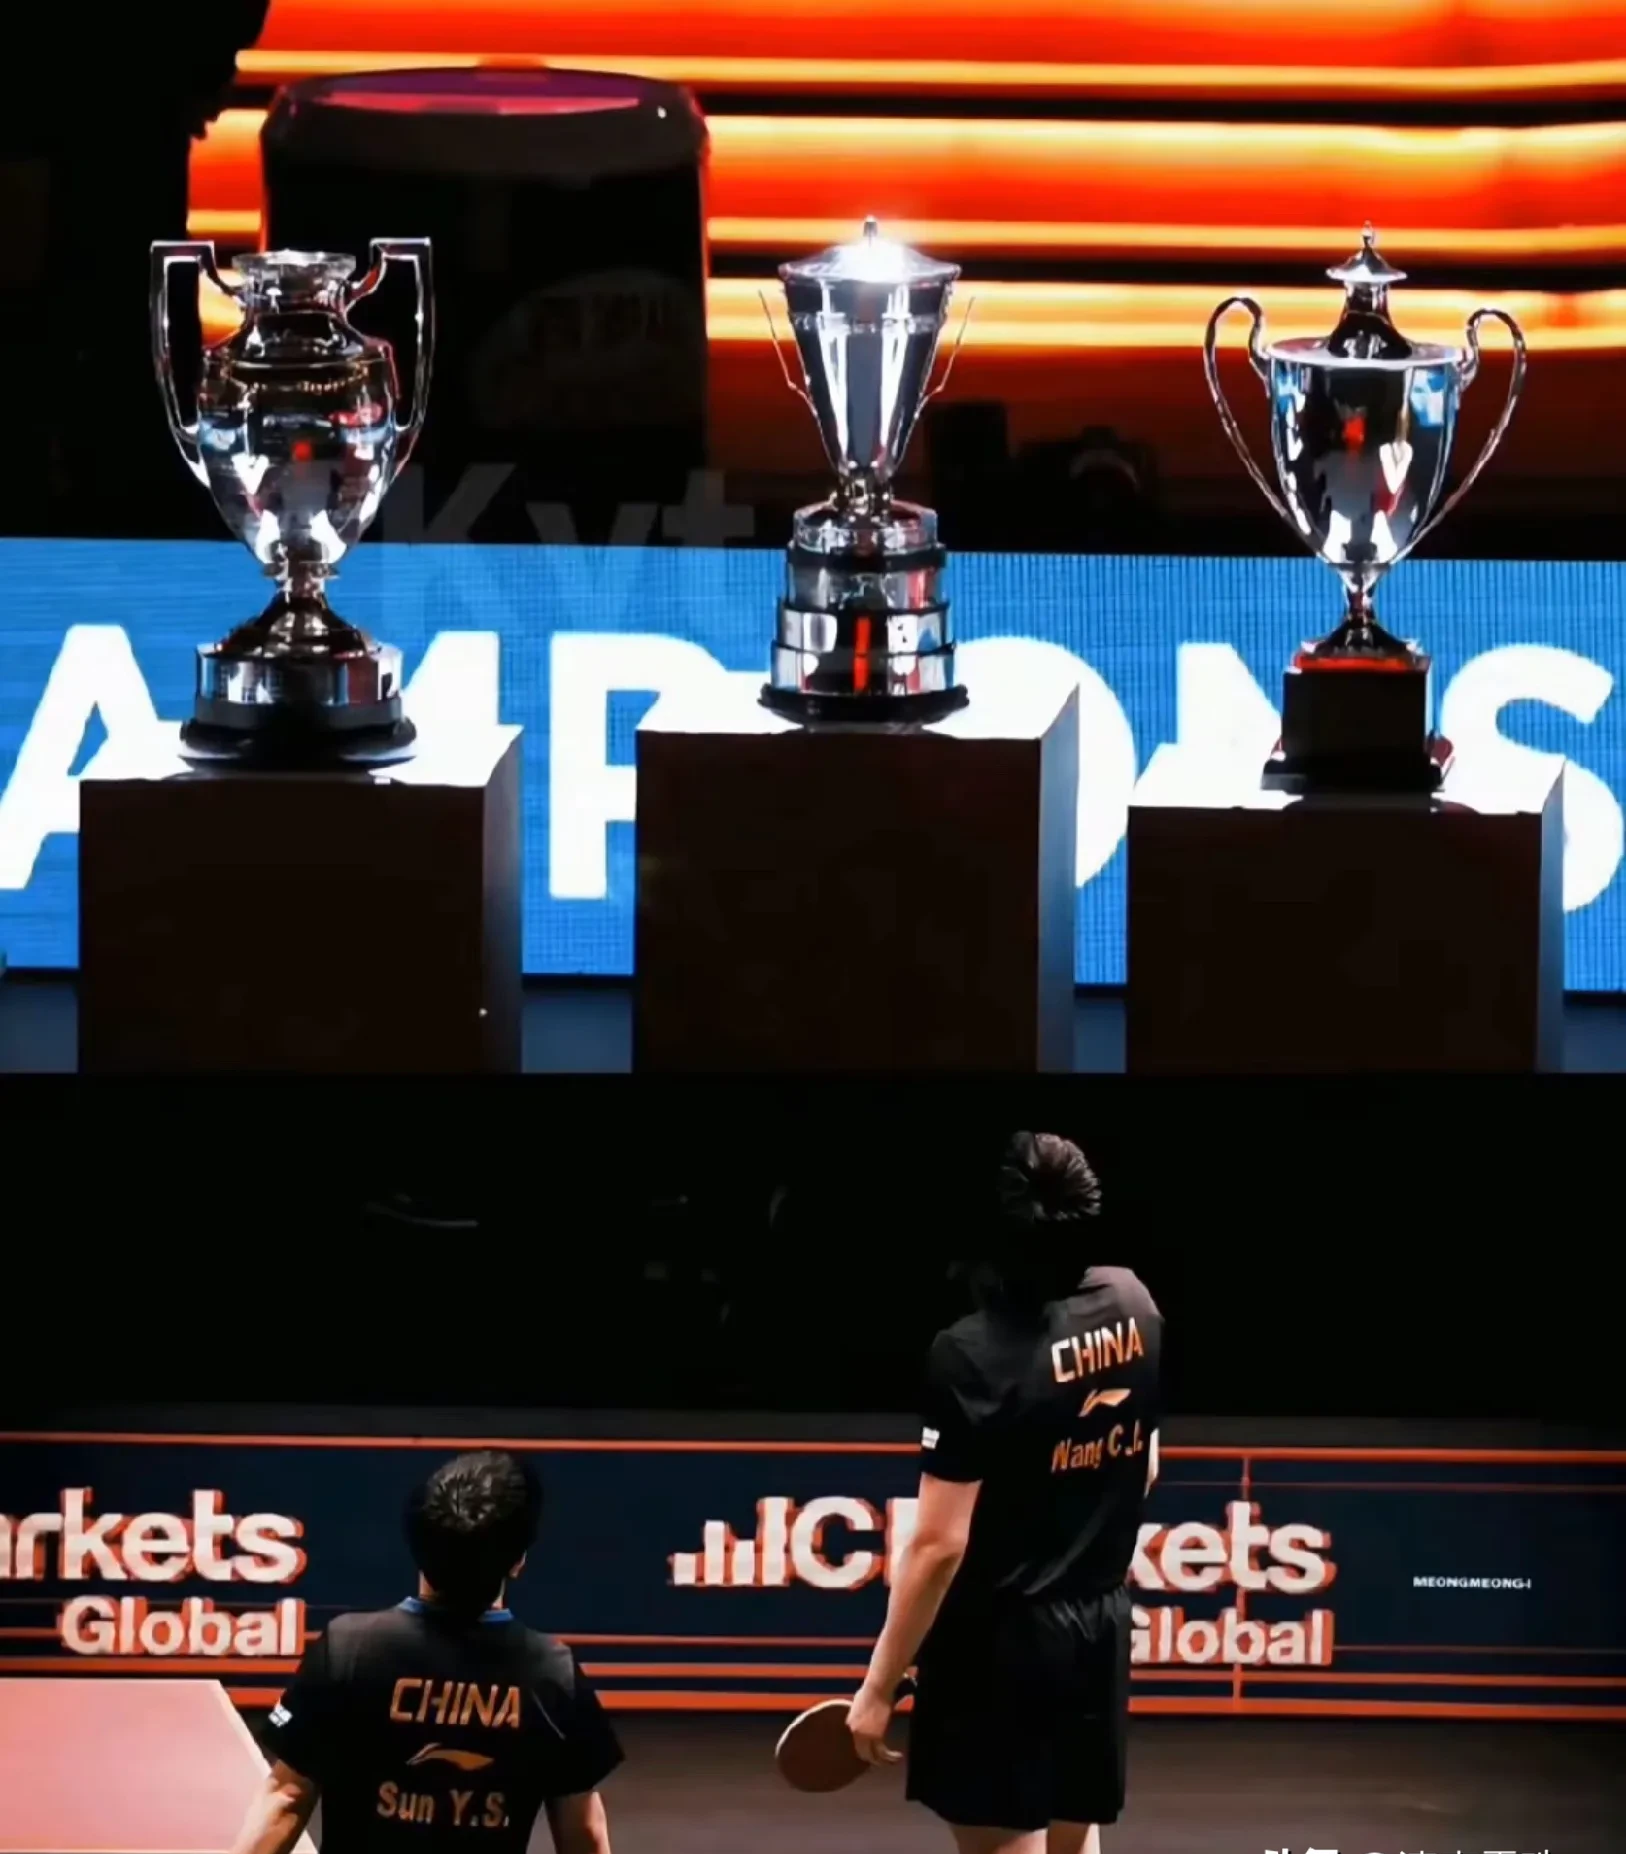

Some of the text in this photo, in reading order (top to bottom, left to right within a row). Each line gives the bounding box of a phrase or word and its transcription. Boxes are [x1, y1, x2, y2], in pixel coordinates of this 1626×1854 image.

[1050, 1316, 1145, 1383] CHINA
[57, 1595, 306, 1656] Global
[389, 1677, 521, 1729] CHINA
[376, 1781, 511, 1828] Sun Y.S.
